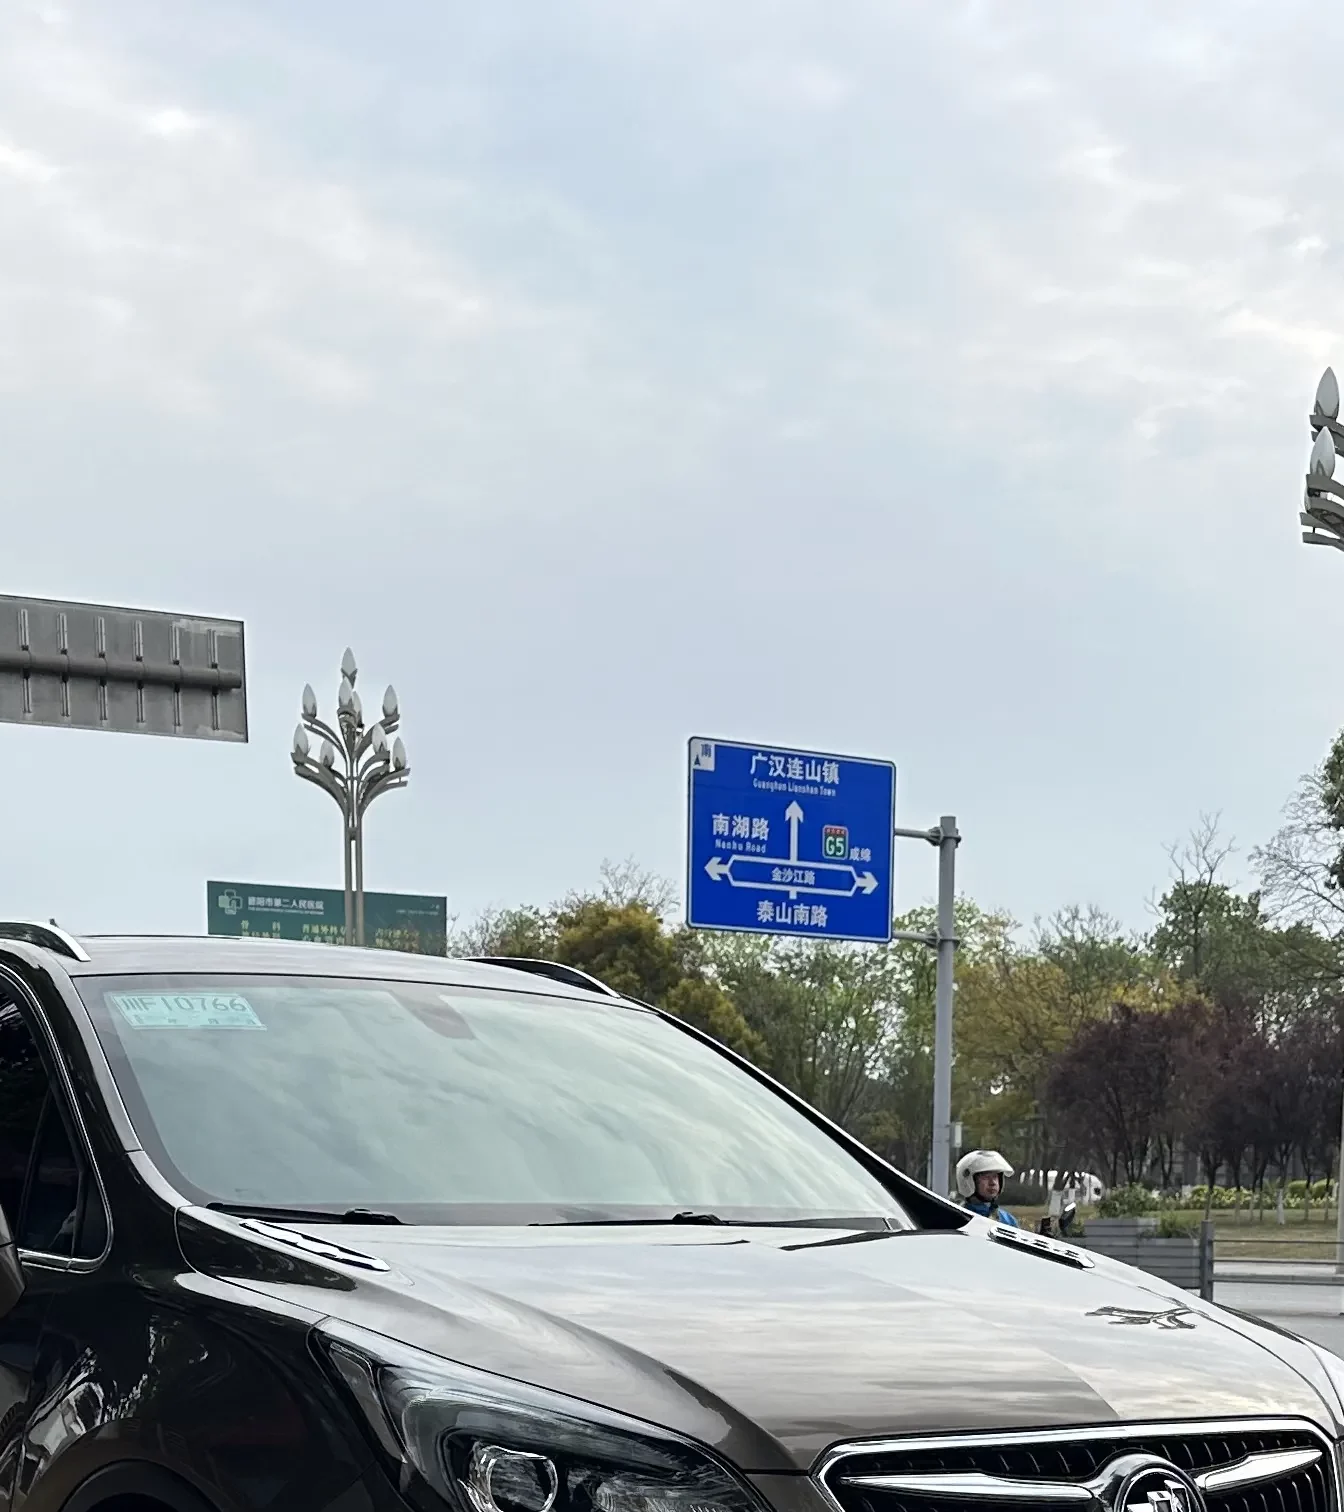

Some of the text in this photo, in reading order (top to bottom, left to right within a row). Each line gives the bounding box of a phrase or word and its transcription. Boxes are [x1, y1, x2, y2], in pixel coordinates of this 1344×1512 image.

[750, 752, 840, 785] 广汉连山镇
[712, 812, 769, 841] 南湖路
[715, 839, 767, 853] Nanhu Road
[825, 836, 845, 856] G5
[771, 867, 815, 885] 金沙江路
[757, 900, 828, 928] 泰山南路
